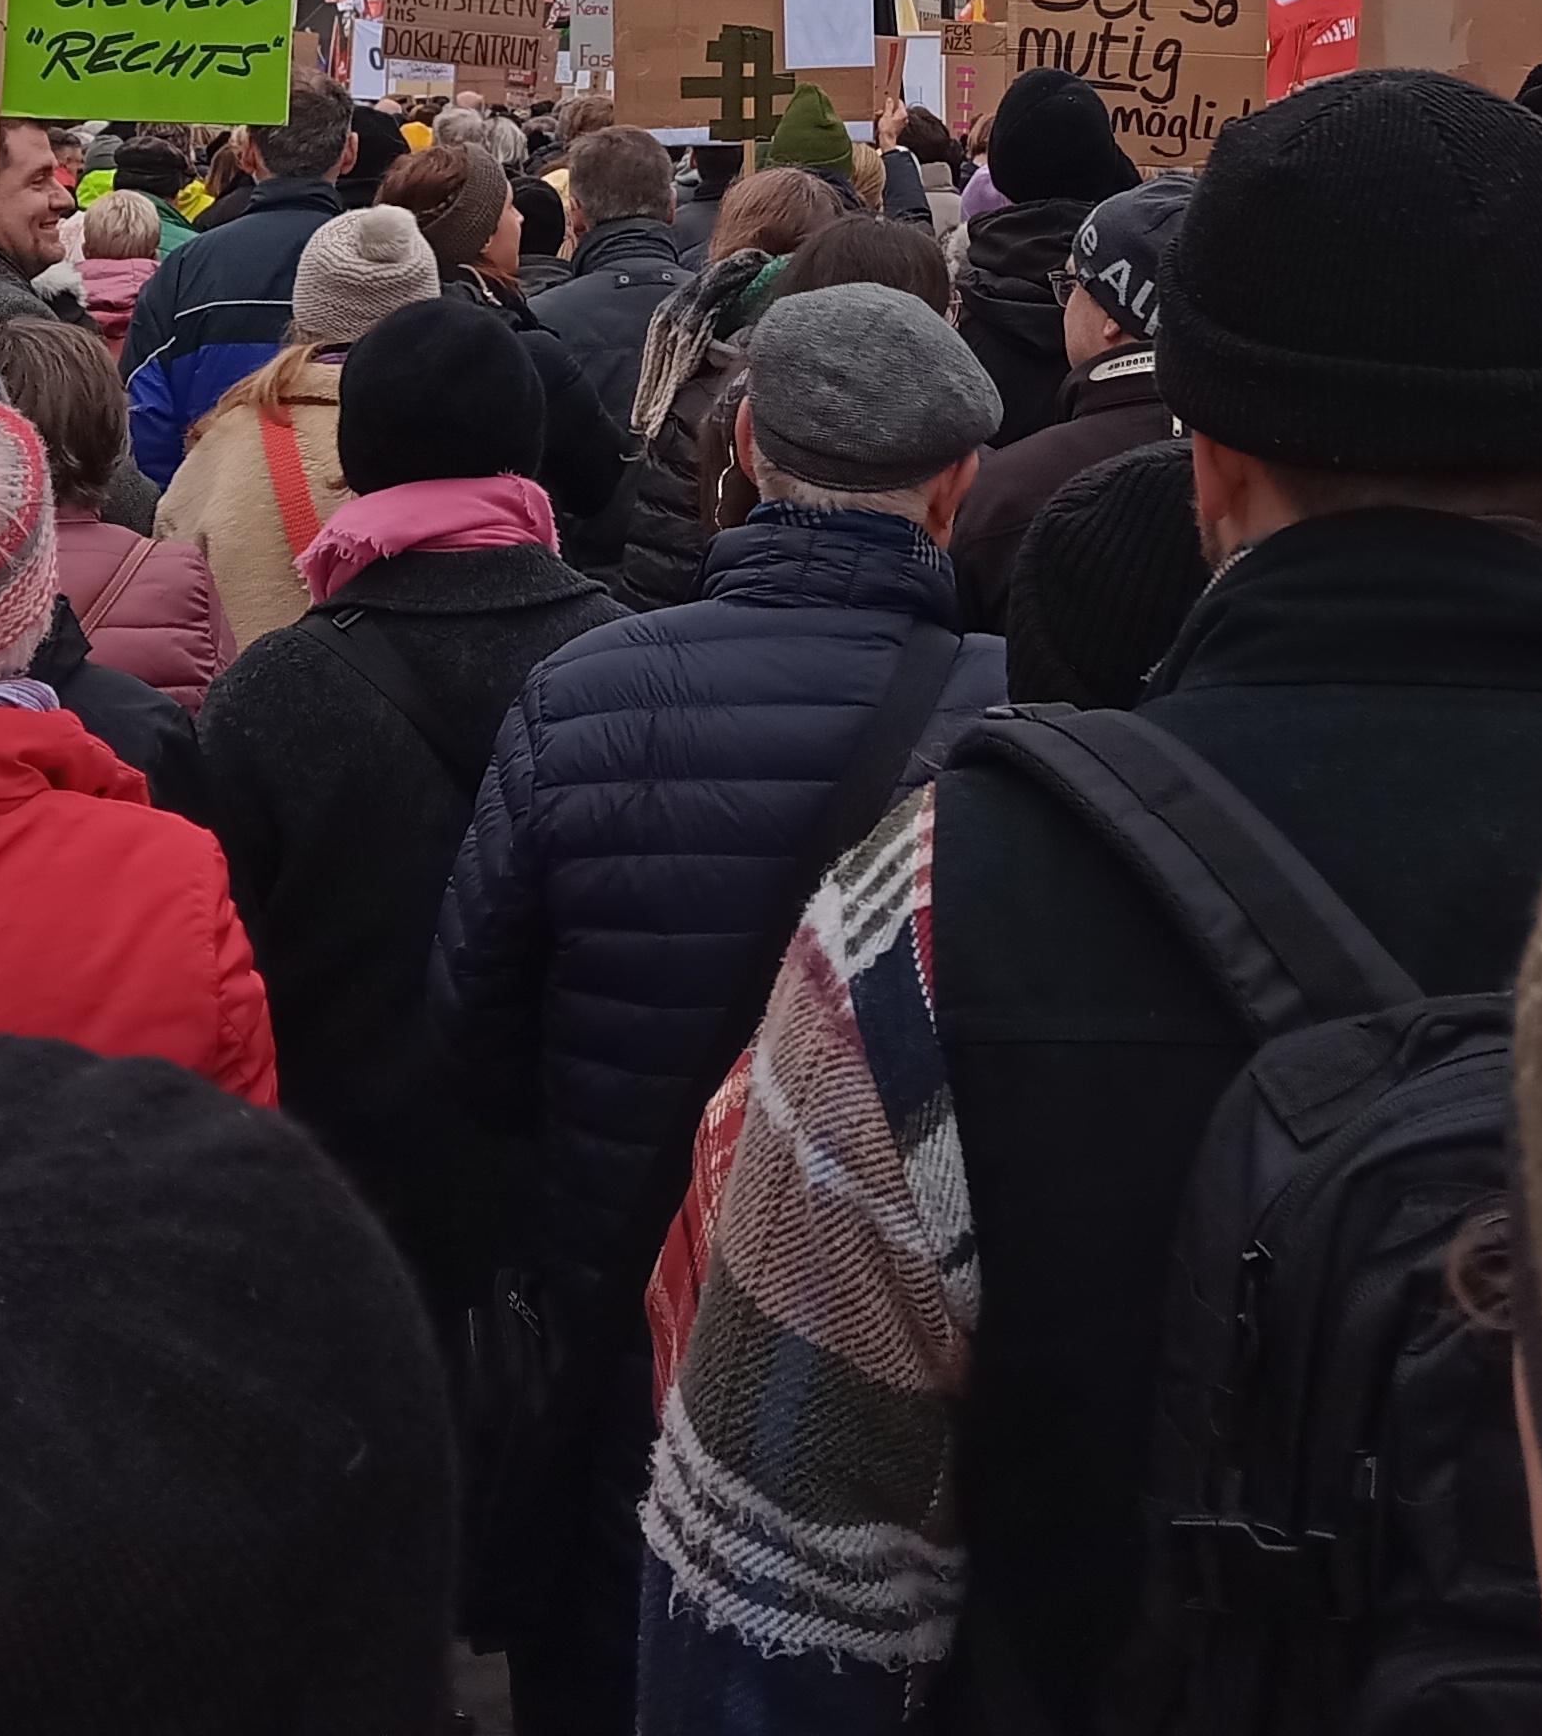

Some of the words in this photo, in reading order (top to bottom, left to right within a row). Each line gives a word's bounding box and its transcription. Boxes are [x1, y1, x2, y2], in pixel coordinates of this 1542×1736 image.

[386, 7, 416, 23] ins
[944, 24, 973, 37] FCK
[944, 37, 973, 51] NZS
[1017, 21, 1183, 105] mutig
